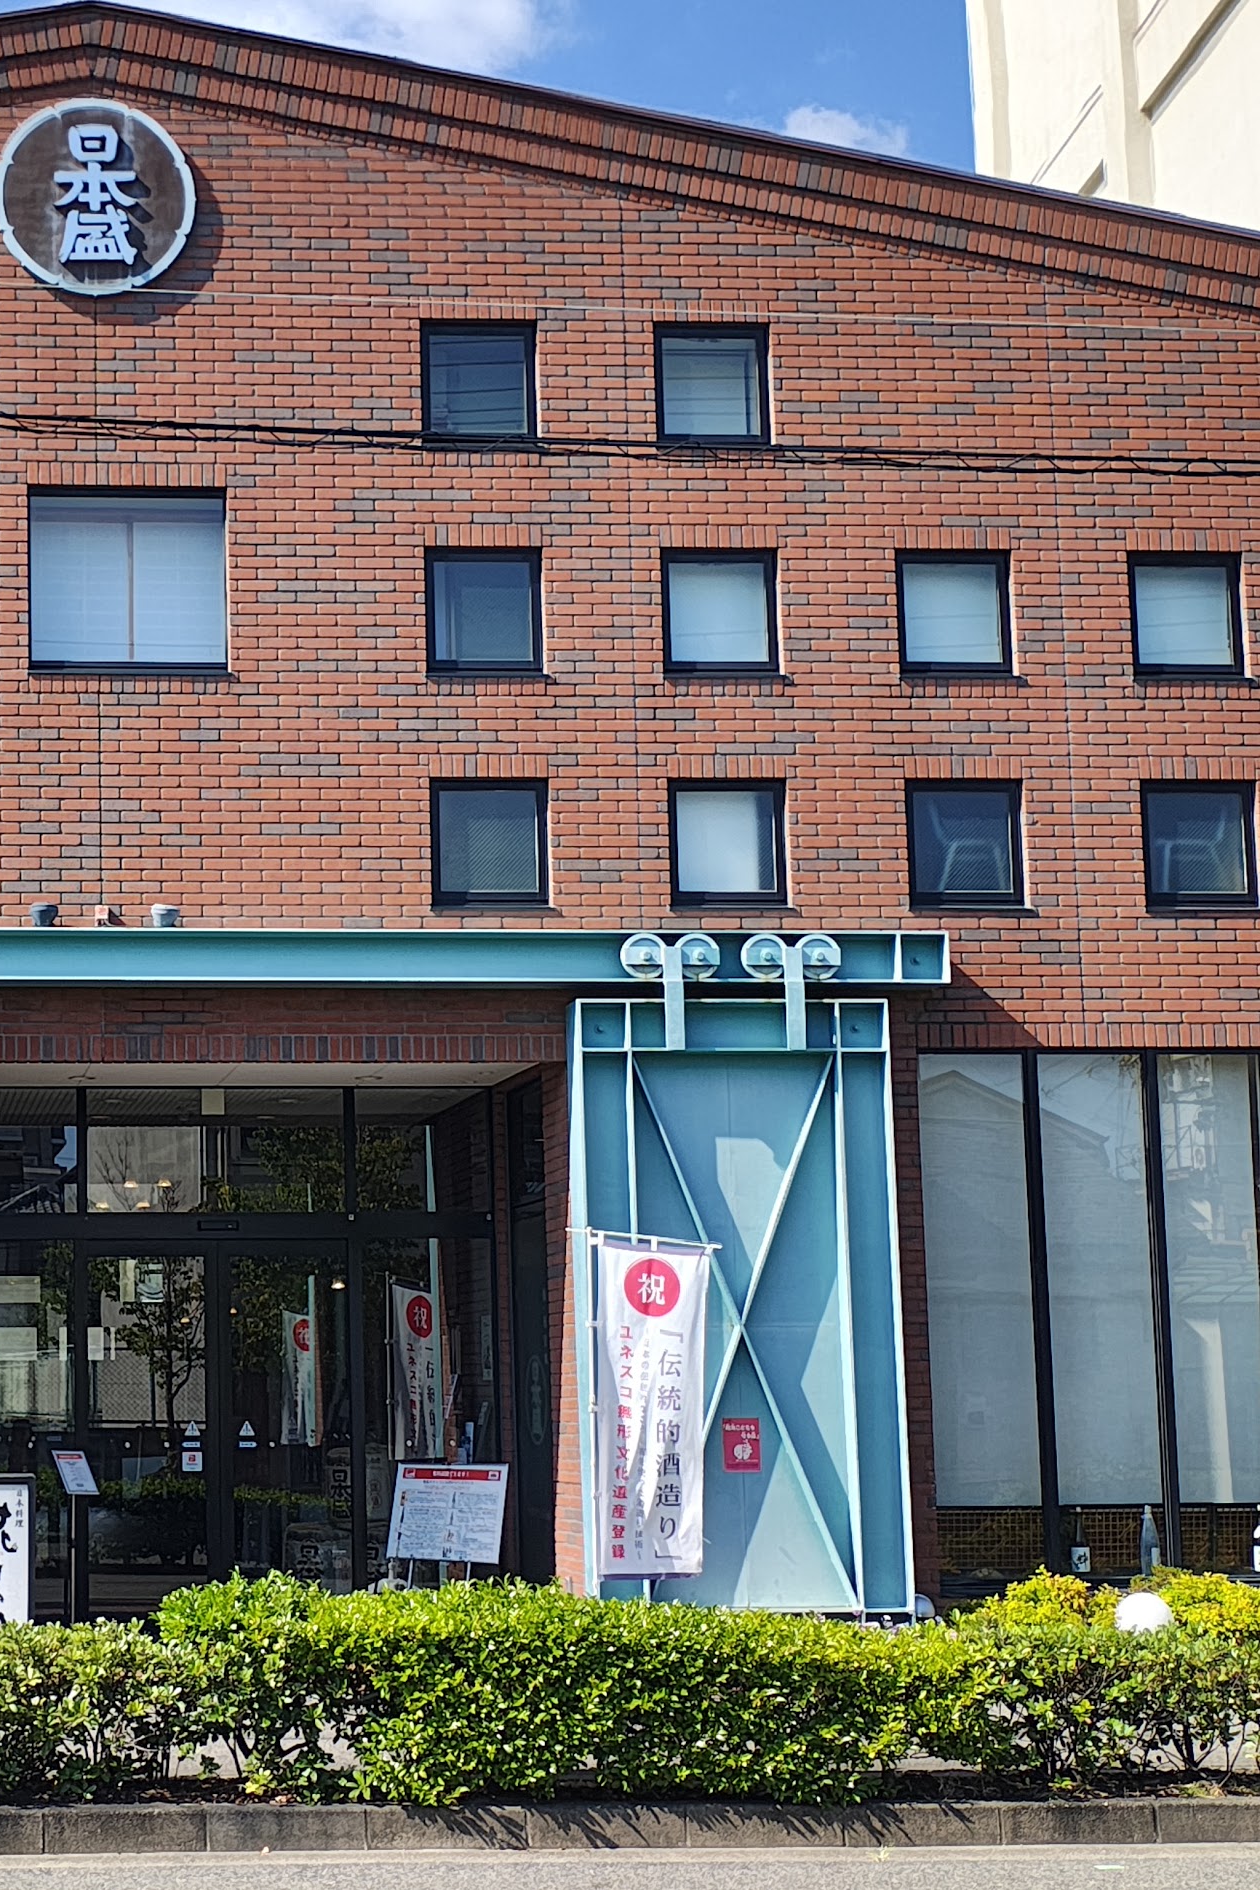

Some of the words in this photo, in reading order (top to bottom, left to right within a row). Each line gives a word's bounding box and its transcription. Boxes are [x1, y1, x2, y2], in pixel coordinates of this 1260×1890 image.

[53, 123, 138, 266] 日本盛
[637, 1273, 666, 1306] 祝
[14, 1490, 25, 1528] 日本料理
